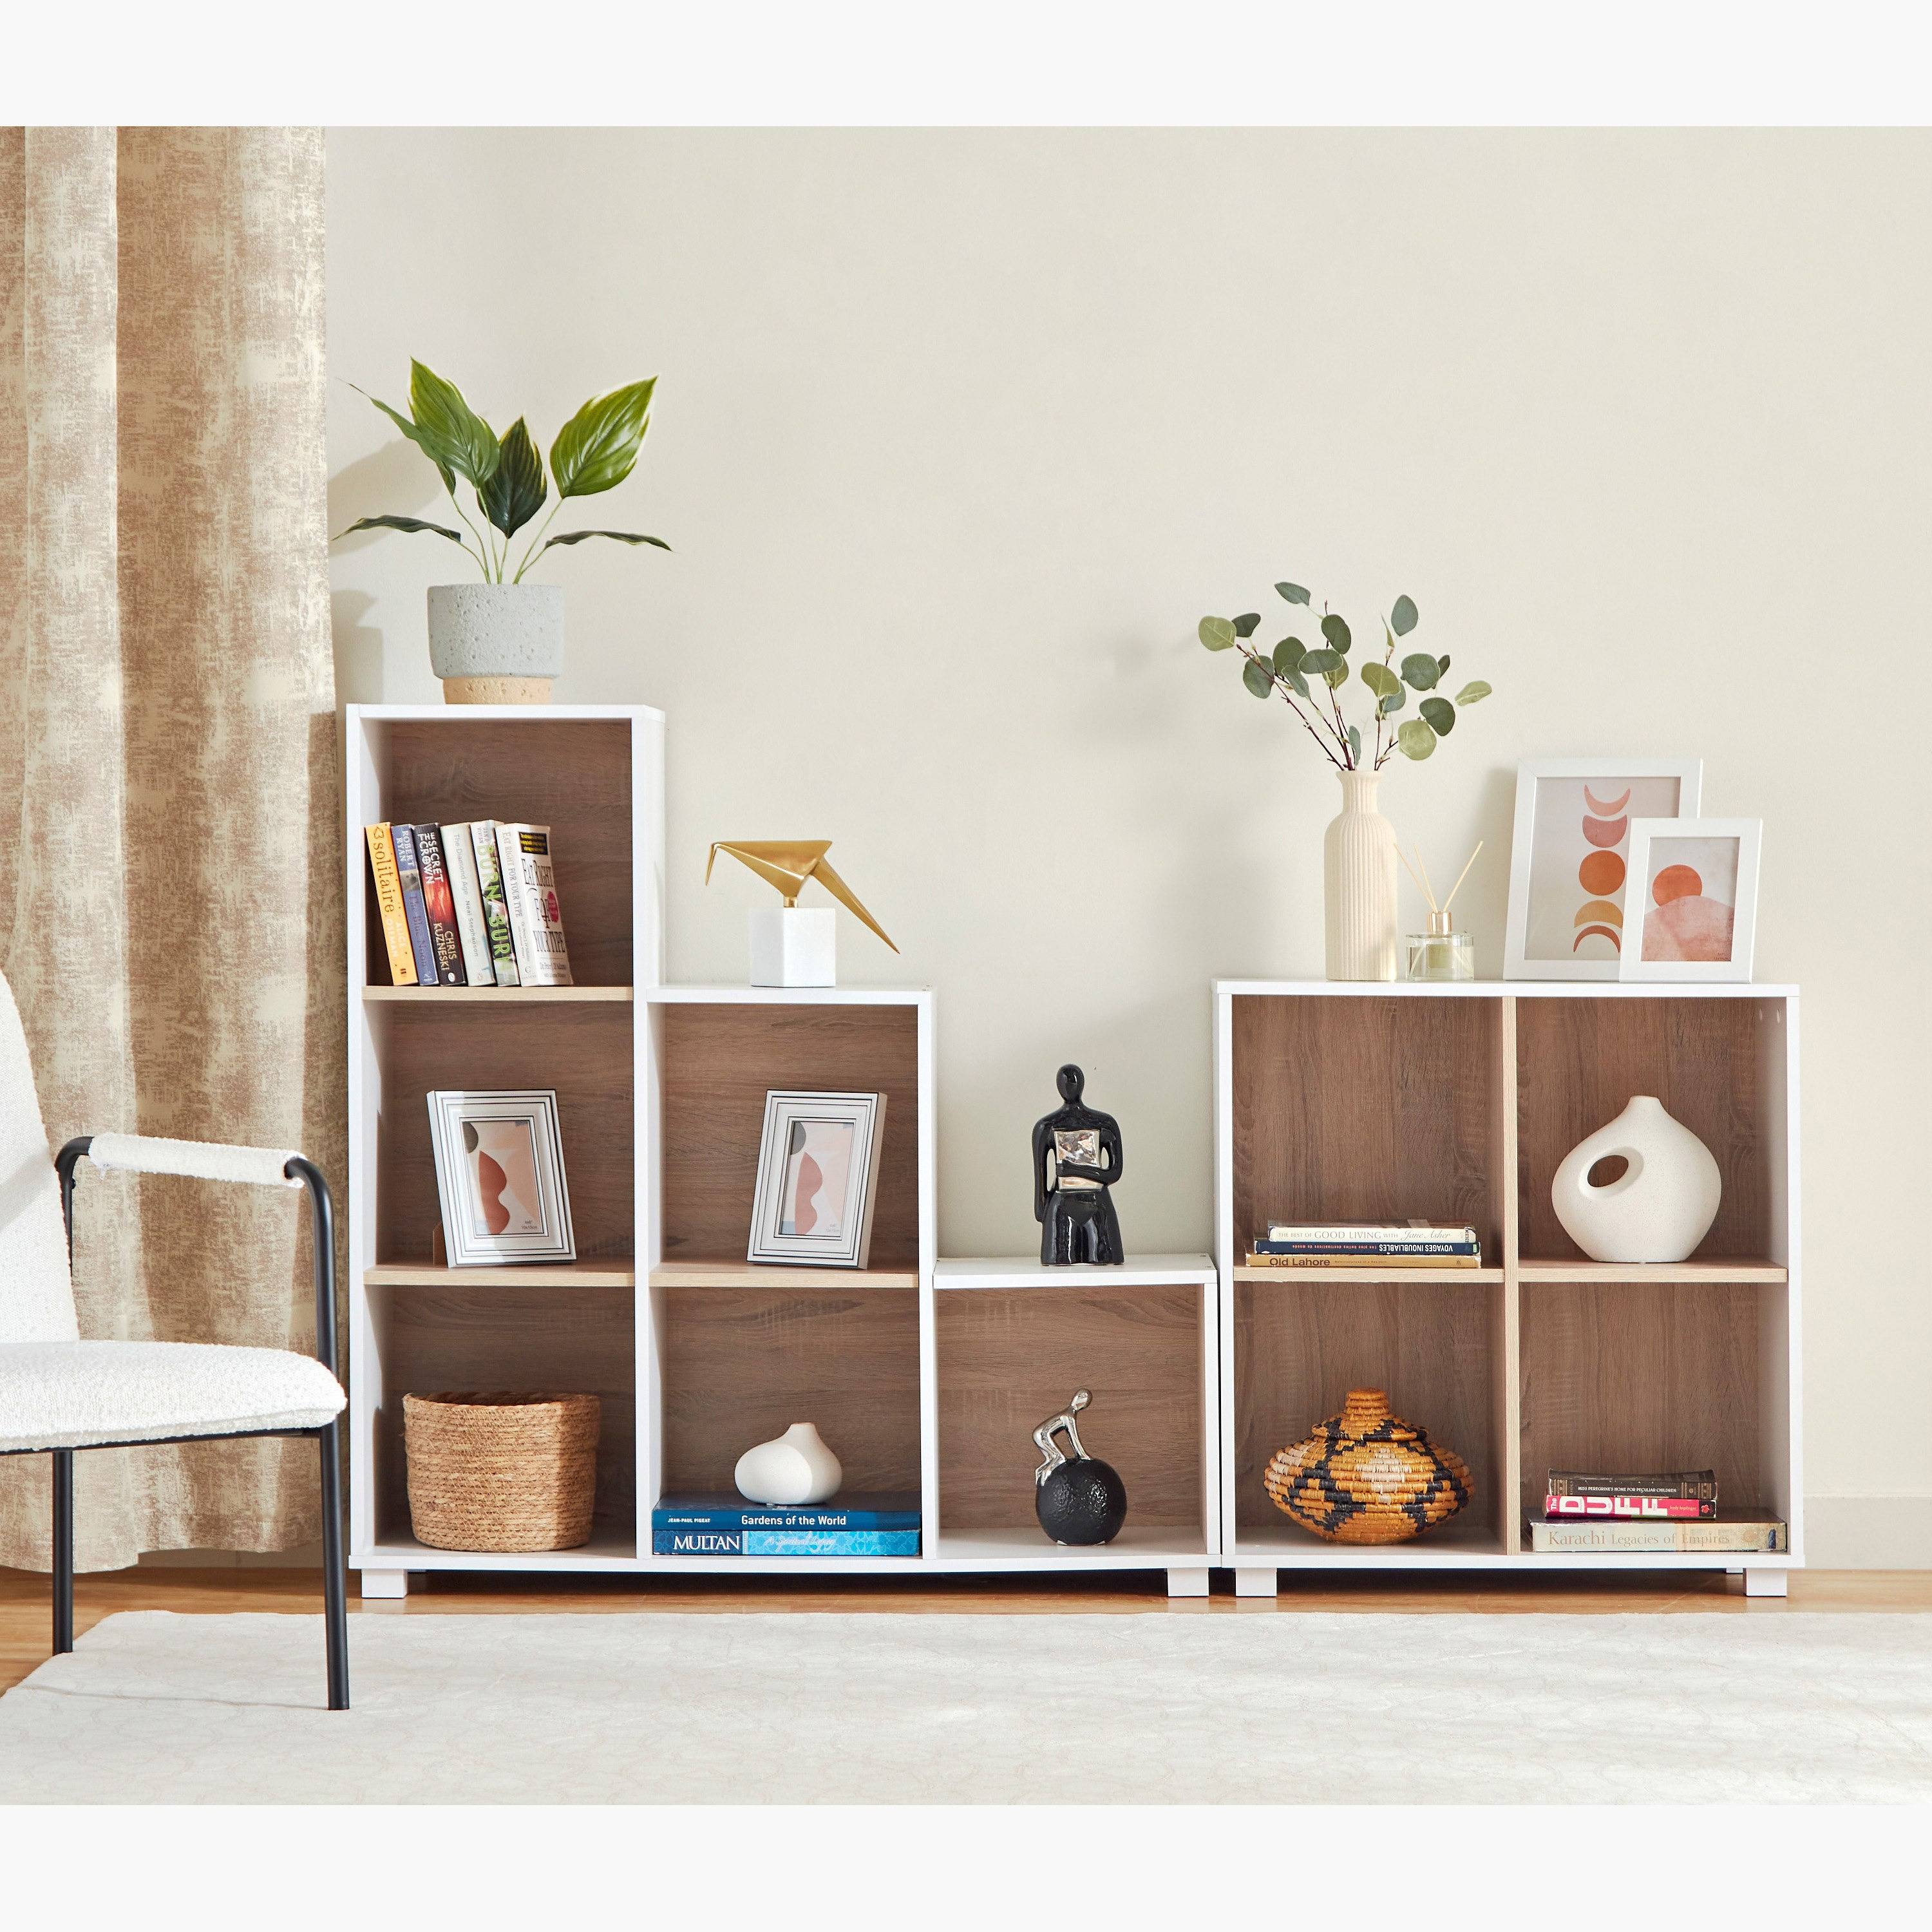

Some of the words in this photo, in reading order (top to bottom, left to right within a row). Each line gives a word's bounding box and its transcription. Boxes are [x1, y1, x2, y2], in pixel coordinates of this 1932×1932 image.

[396, 838, 406, 862] RYAN
[402, 830, 415, 867] ROBERT
[417, 832, 435, 841] THE
[428, 840, 444, 882] SECRET
[505, 846, 515, 866] RIGHT
[419, 841, 435, 884] CROWN
[457, 849, 467, 879] Diamond
[477, 844, 502, 900] BURN
[508, 867, 516, 881] FOR
[374, 842, 395, 913] solitaire
[511, 882, 520, 900] YOUR
[514, 902, 523, 917] TYPE
[396, 922, 406, 947] ALICE
[433, 922, 450, 971] KUZNESKI
[444, 931, 457, 960] CHRIS
[1314, 1231, 1345, 1239] GOOD
[1400, 1230, 1424, 1241] Jane
[1424, 1230, 1450, 1239] Asher
[1269, 1258, 1288, 1266] Old
[1293, 1258, 1331, 1266] Lahore
[741, 1515, 783, 1525] Gardens
[785, 1515, 797, 1525] of
[799, 1516, 815, 1525] the
[817, 1515, 846, 1525] World
[674, 1535, 740, 1550] MULTAN
[1548, 1530, 1605, 1545] Karachi
[1612, 1533, 1659, 1547] Legacies
[1663, 1533, 1676, 1544] of
[1682, 1533, 1730, 1547] Empires
